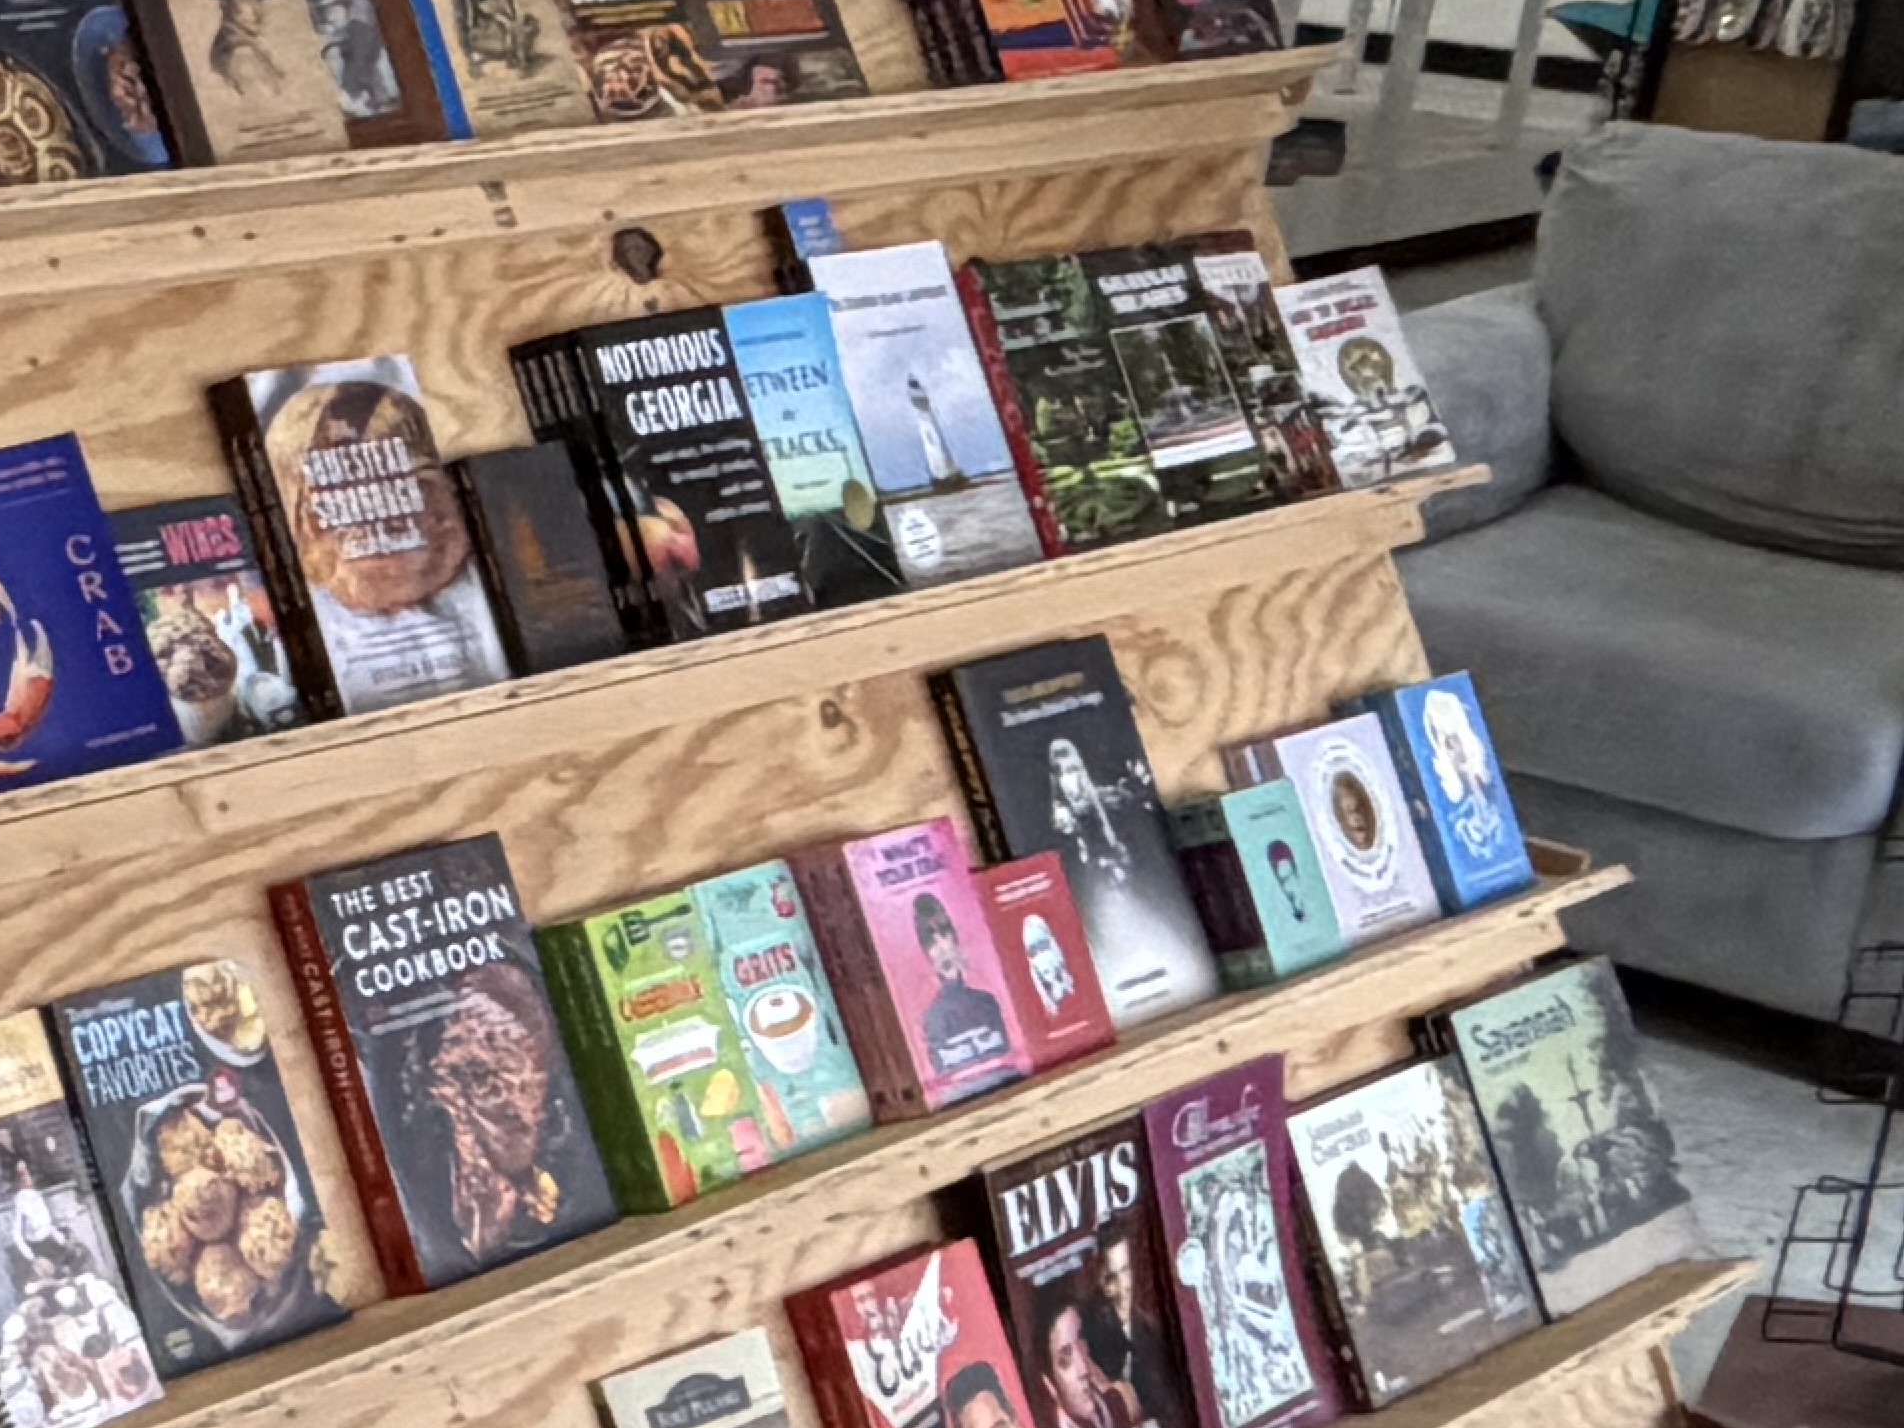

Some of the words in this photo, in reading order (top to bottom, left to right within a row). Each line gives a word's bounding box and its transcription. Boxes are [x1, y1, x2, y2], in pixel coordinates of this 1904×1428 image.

[595, 327, 727, 385] NOTORIOUS
[745, 360, 830, 399] ETWEEN
[624, 376, 744, 436] GEORGIA
[159, 512, 242, 567] WINGS
[64, 532, 136, 677] CRAB
[330, 885, 376, 920] THE
[382, 868, 435, 907] BEST
[341, 882, 517, 963] CAST-IRON
[353, 932, 506, 999] COOKBOOK
[69, 999, 188, 1066] COPYCAT
[81, 1041, 200, 1109] FAVORITES
[1000, 1139, 1140, 1259] ELVIS
